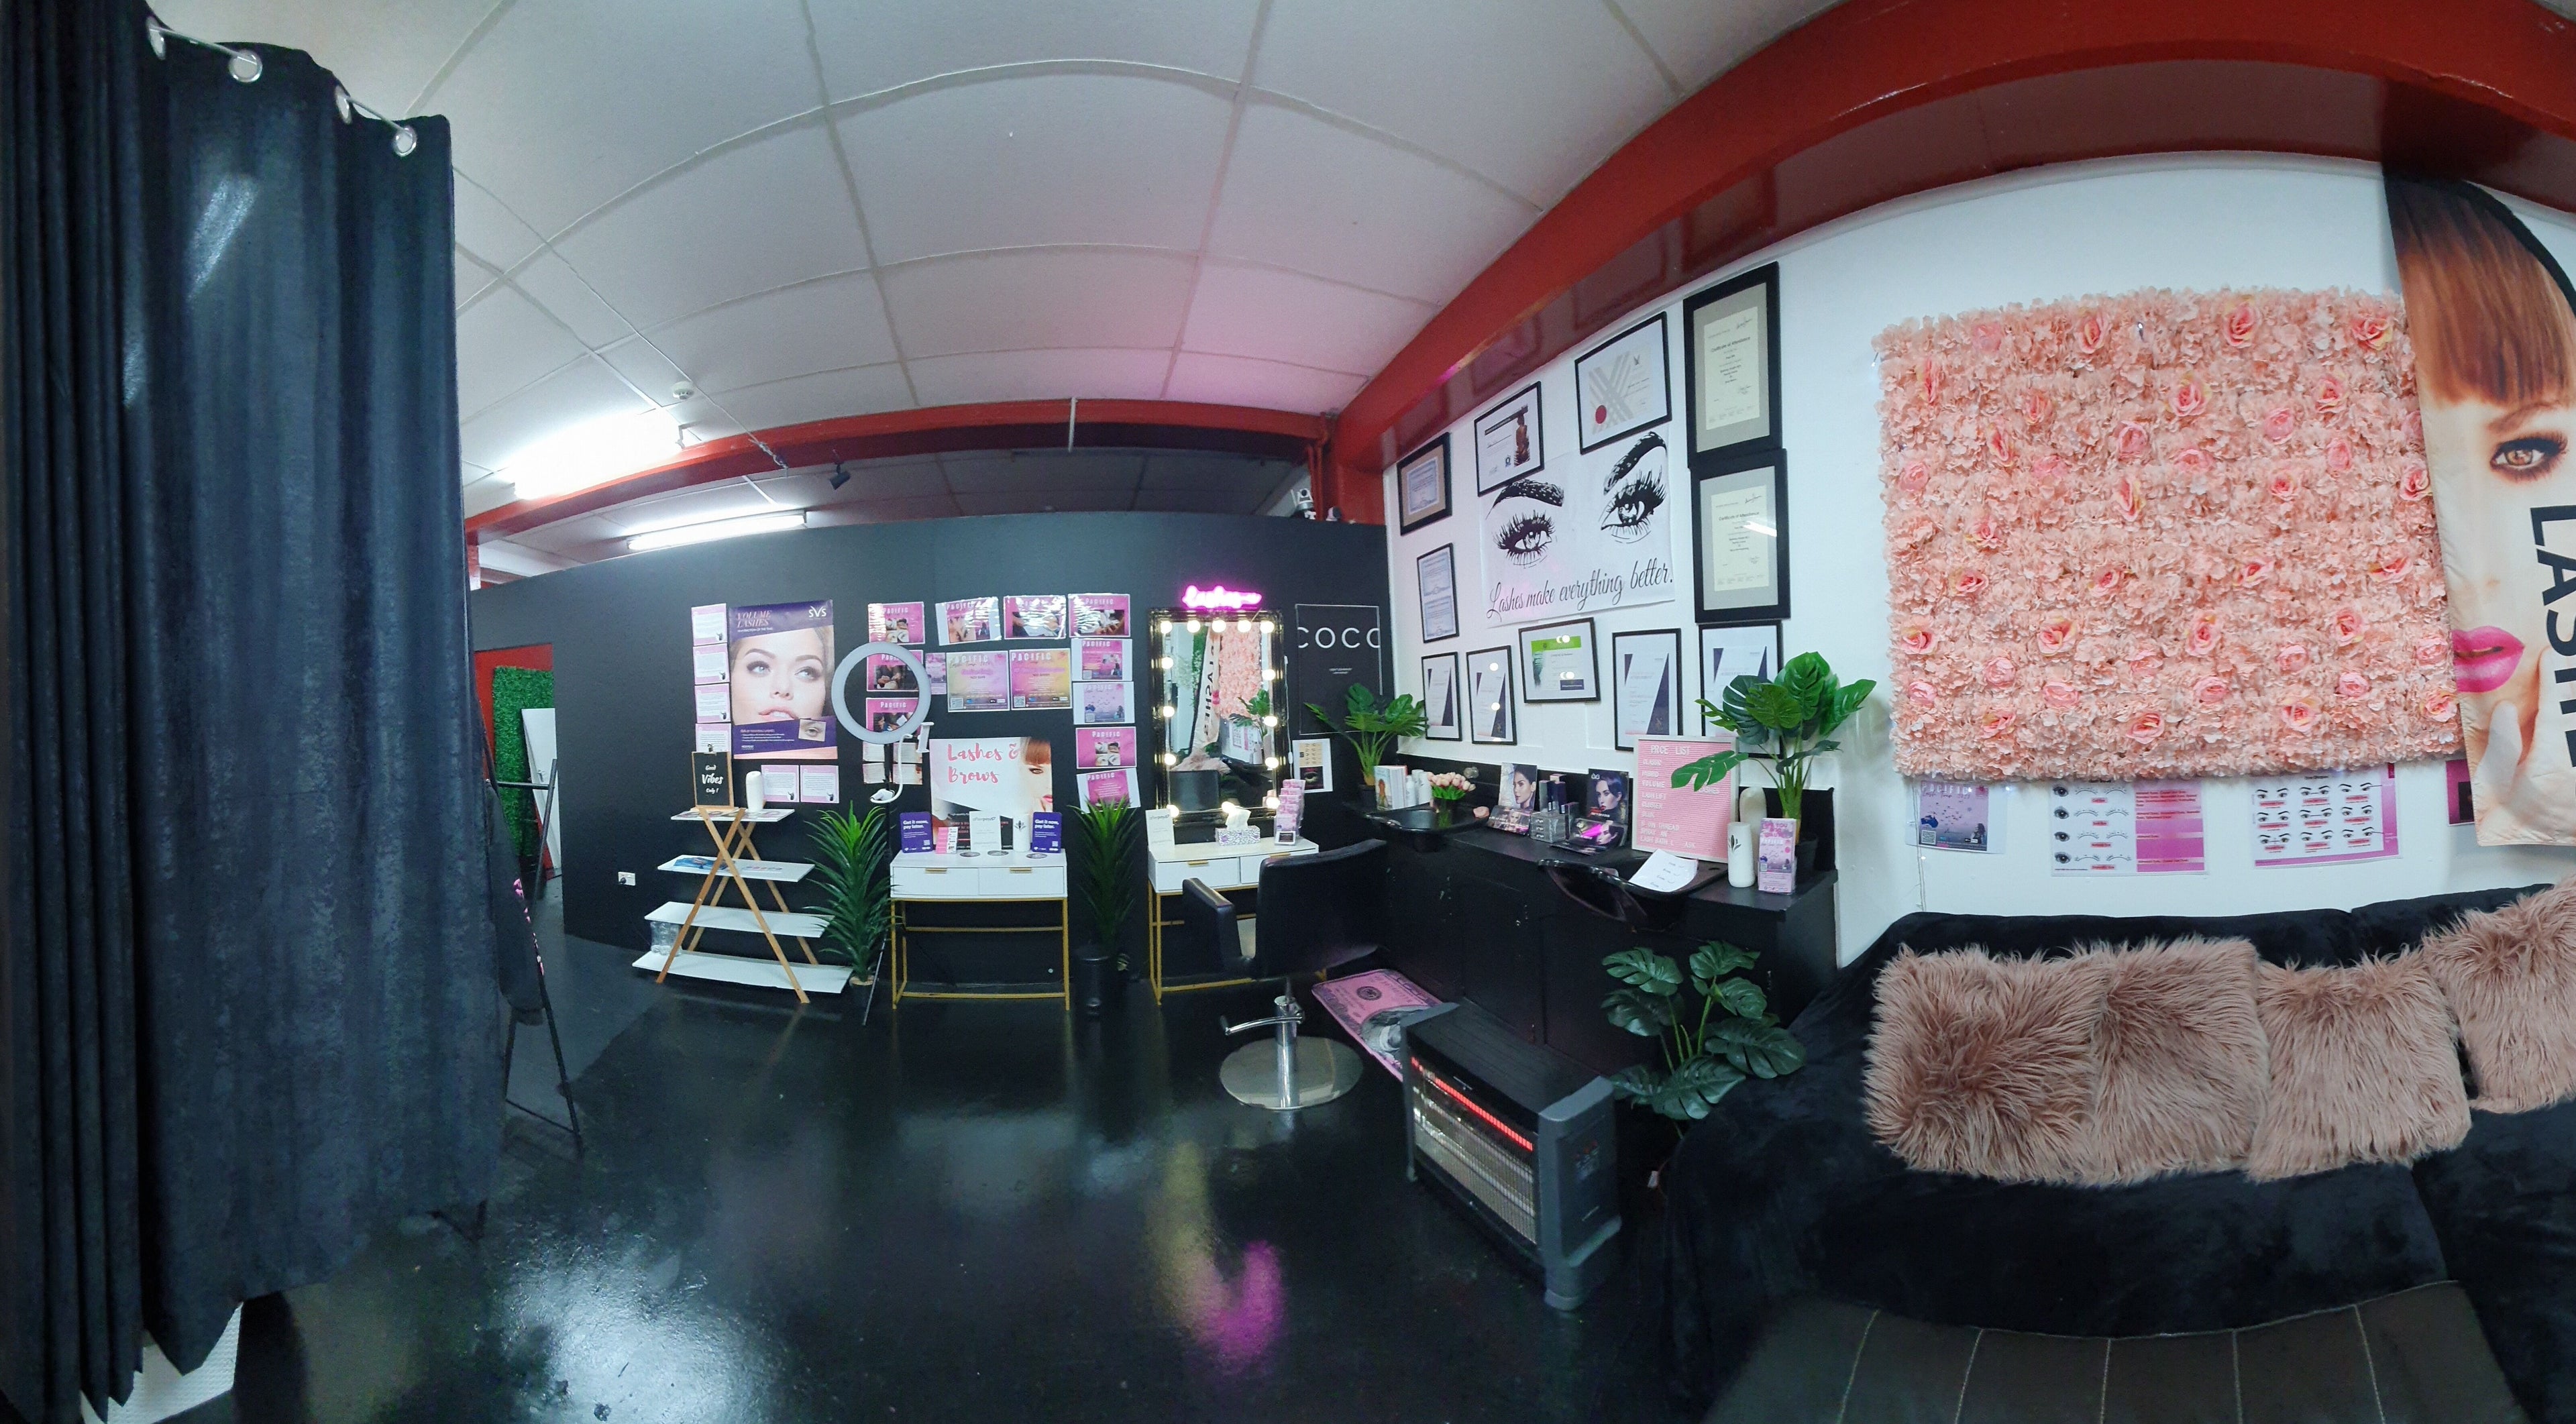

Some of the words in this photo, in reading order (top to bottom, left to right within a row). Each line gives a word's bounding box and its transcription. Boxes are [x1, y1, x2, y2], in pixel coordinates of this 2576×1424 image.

[1486, 581, 1524, 623] Lashes
[1526, 579, 1556, 608] make
[1560, 568, 1623, 611] everything
[1630, 557, 1673, 590] better.
[737, 610, 772, 620] VOLUME
[808, 606, 826, 618] SVS
[737, 618, 769, 628] LASHES
[1012, 651, 1052, 661] PACIFIC
[1091, 730, 1121, 738] PACIFIC
[948, 743, 1003, 762] Lashes
[1008, 743, 1022, 760] &
[1676, 747, 1690, 755] LIST
[702, 773, 724, 785] Vibes
[948, 765, 1000, 785] Brows
[1642, 780, 1665, 788] VOLUME
[1921, 783, 1969, 796] PACIFIC
